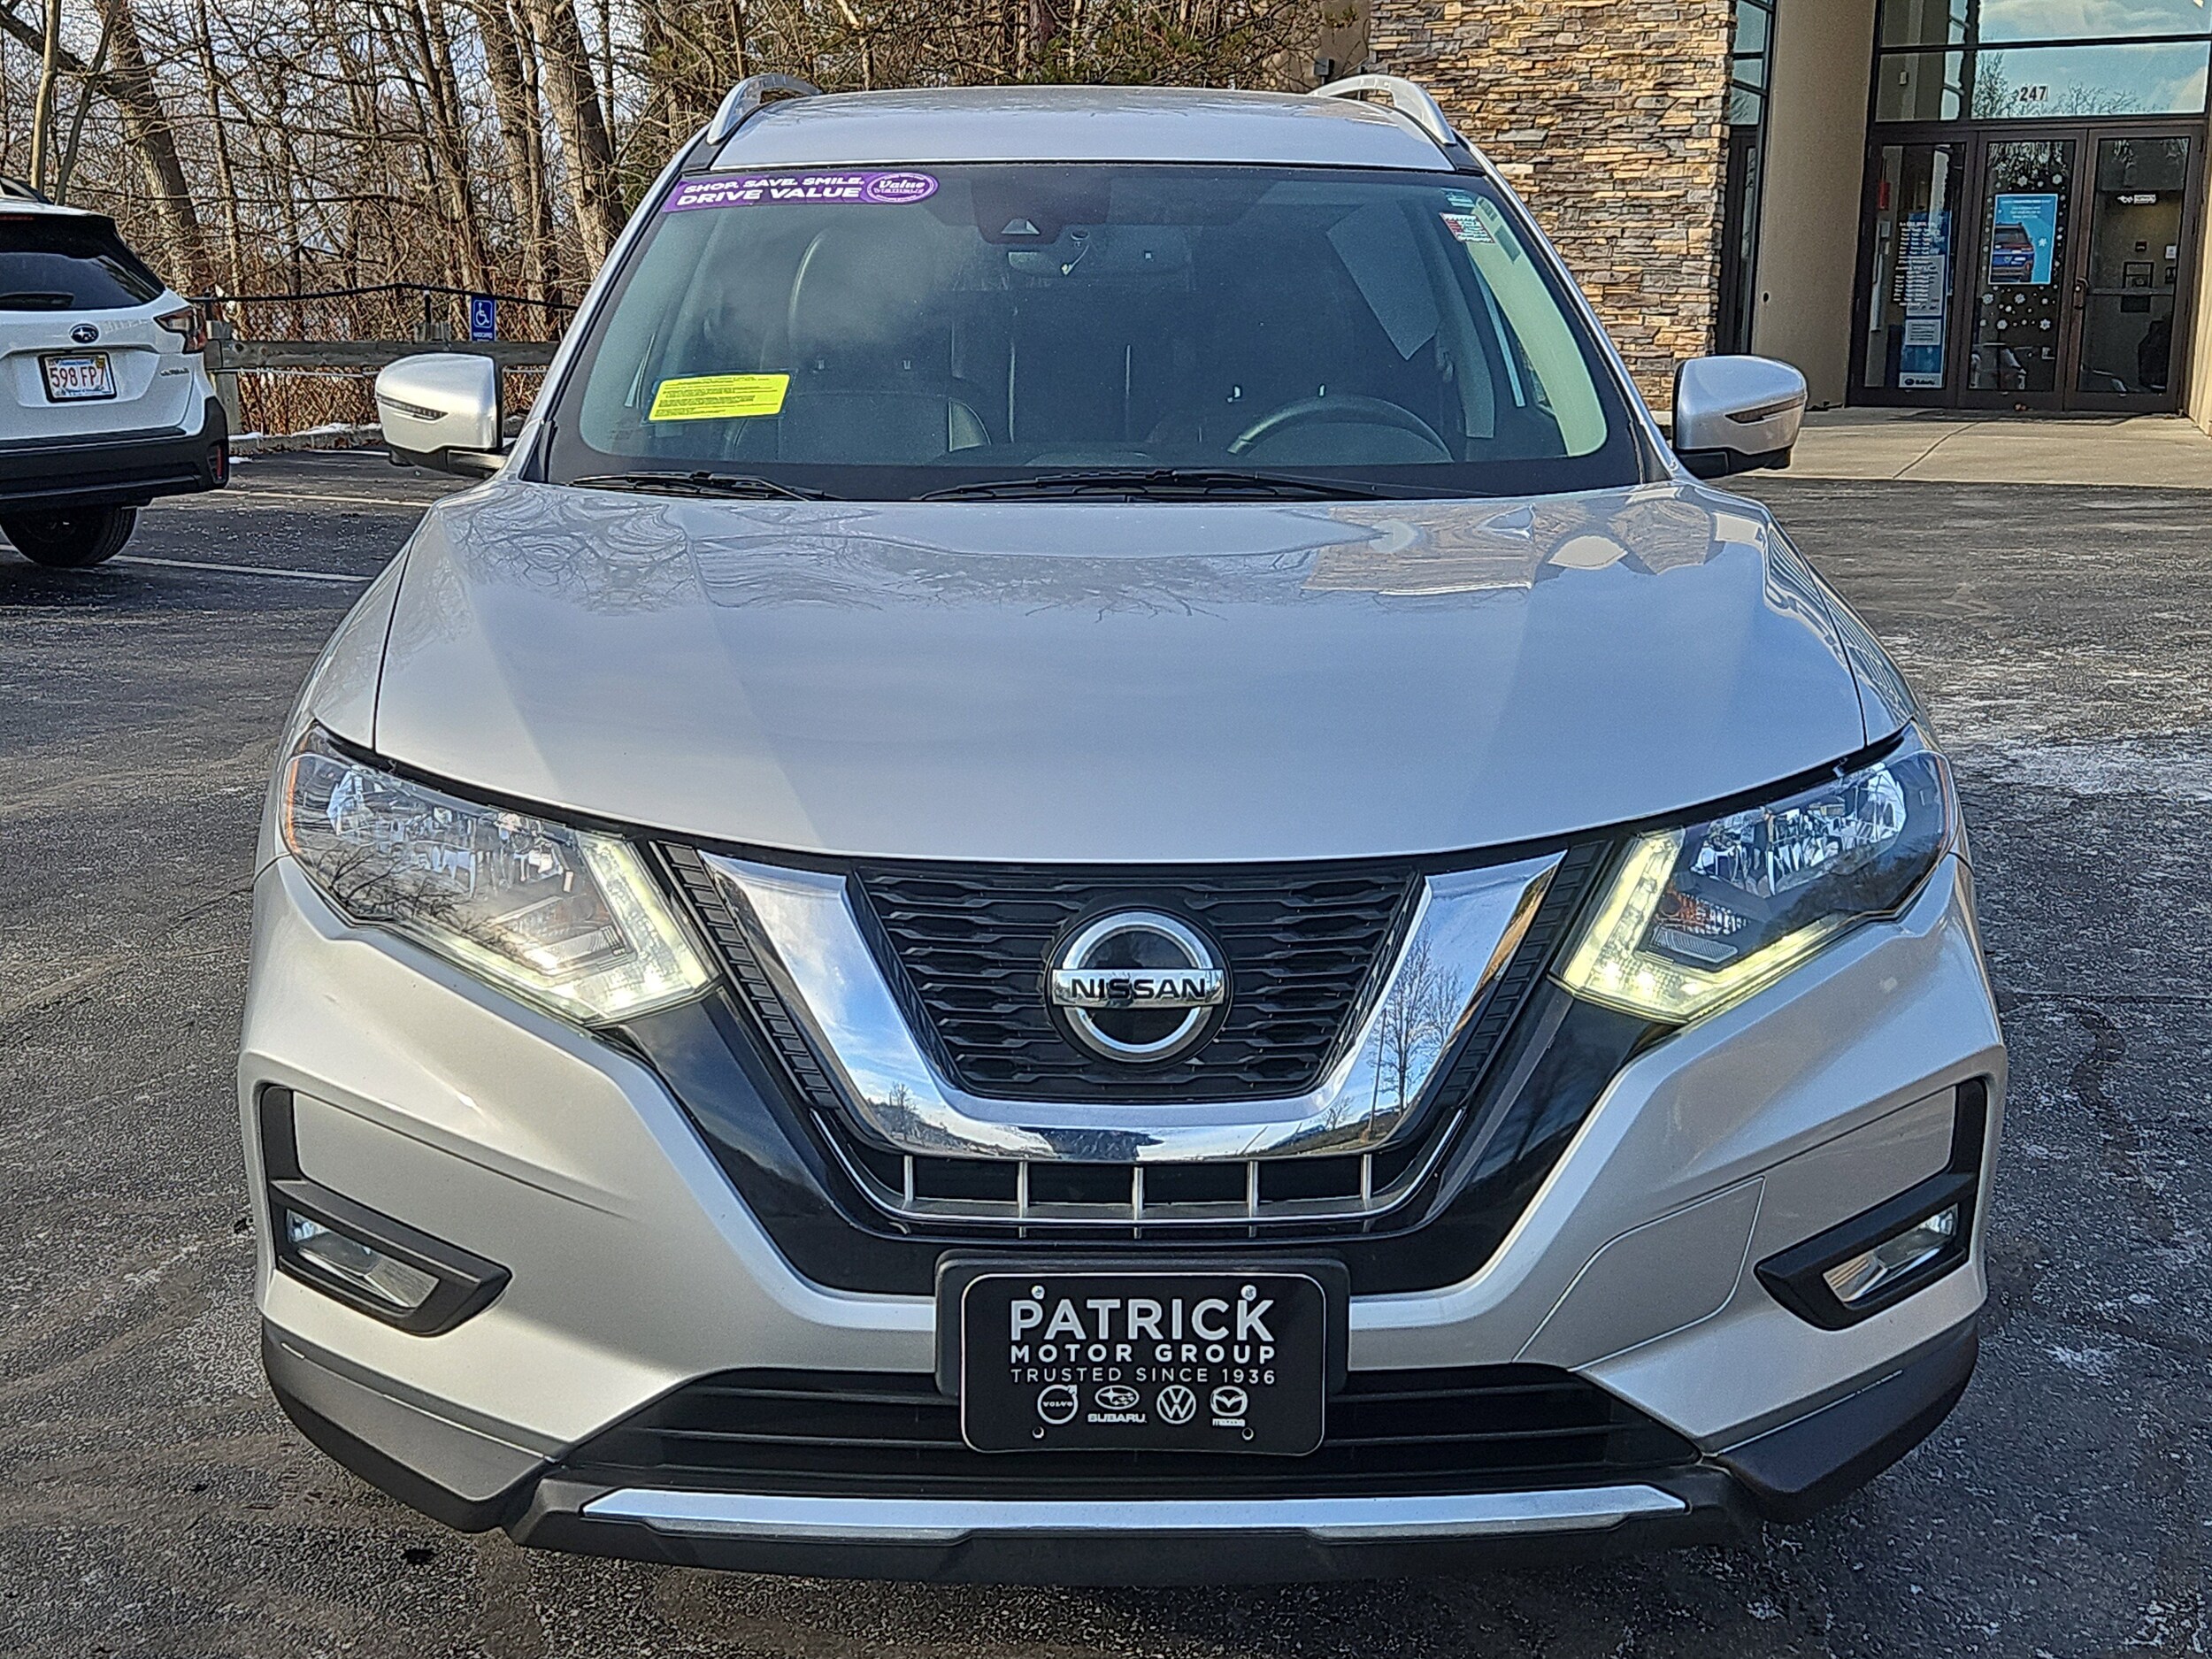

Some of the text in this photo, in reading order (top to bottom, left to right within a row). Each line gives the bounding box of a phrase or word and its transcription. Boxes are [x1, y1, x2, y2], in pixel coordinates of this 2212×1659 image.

[2019, 85, 2047, 102] 247
[803, 177, 865, 186] SMILE.
[879, 179, 926, 189] Value
[676, 188, 763, 206] DRIVE
[769, 187, 863, 199] VALUE
[49, 366, 79, 388] 598
[1071, 978, 1206, 999] NISSAN
[1010, 1298, 1275, 1342] PATRICK
[1010, 1344, 1275, 1364] MOTOR GROUP
[1010, 1367, 1275, 1384] TRUSTED SINCE 1936
[1087, 1413, 1146, 1423] SUBARU
